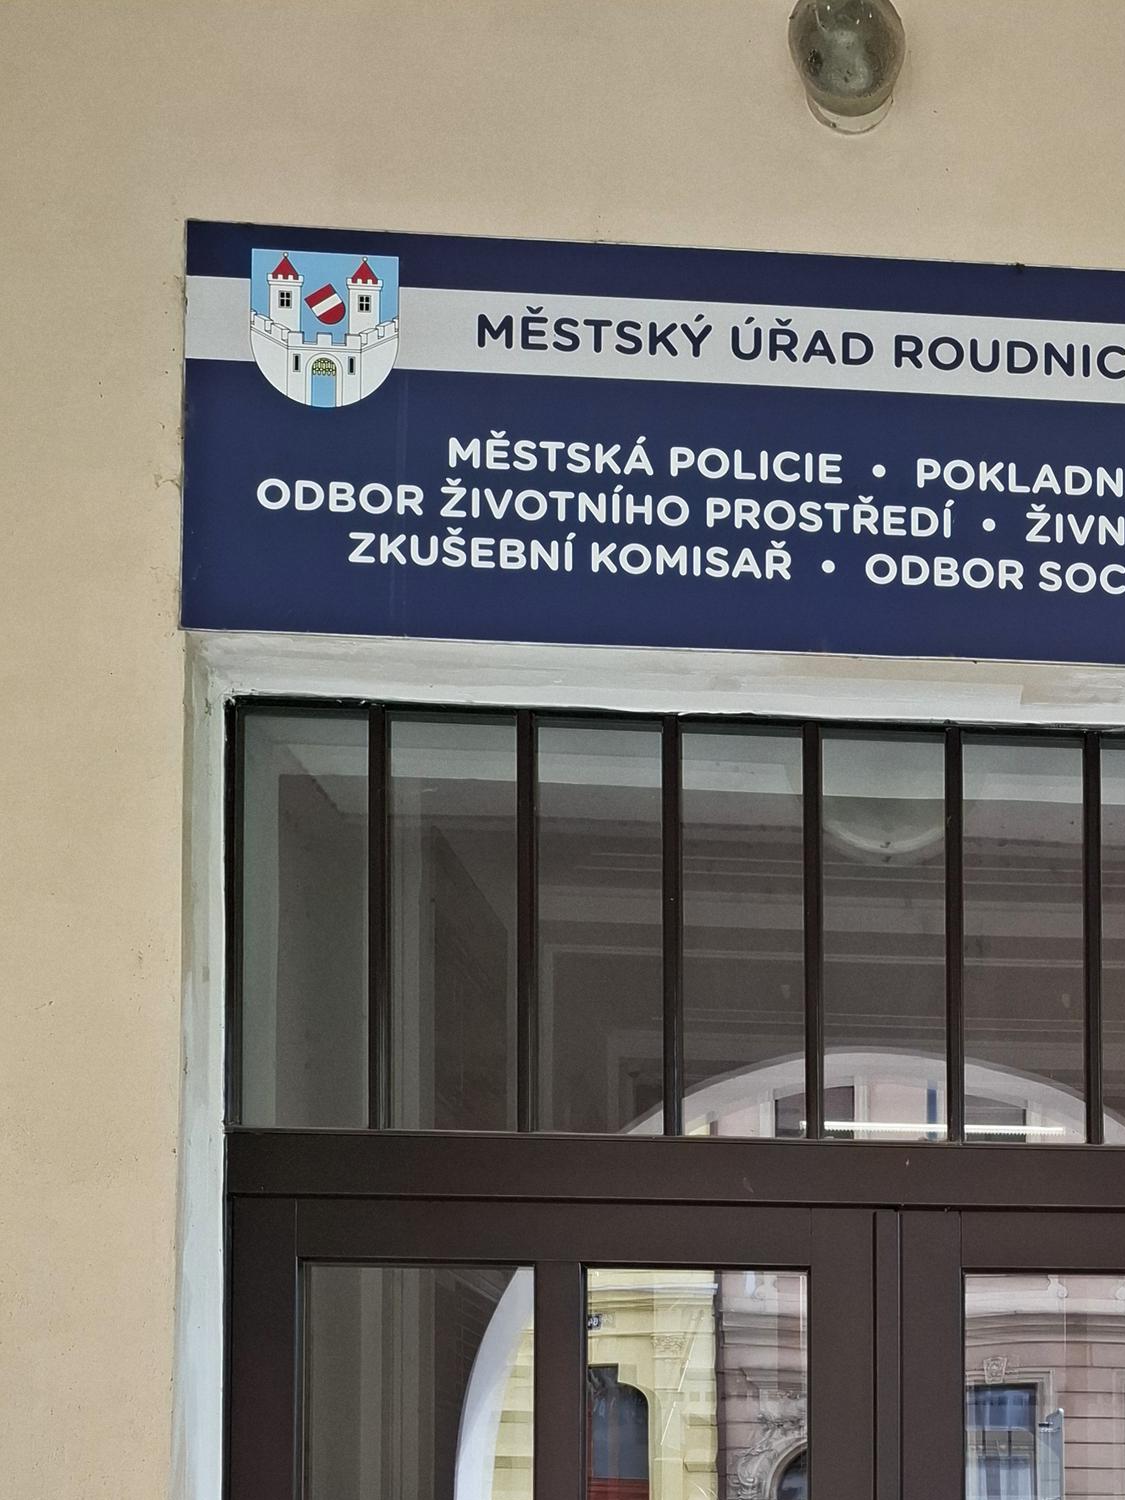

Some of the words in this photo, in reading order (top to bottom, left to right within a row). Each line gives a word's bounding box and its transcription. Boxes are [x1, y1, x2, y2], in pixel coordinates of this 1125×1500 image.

[477, 305, 713, 358] MĚSTSKÝ
[731, 316, 874, 366] ÚŘAD
[448, 429, 654, 476] MĚSTSKÁ
[669, 446, 843, 484] POLICIE
[256, 478, 424, 516] ODBOR
[439, 477, 690, 527] ŽIVOTNÍHO
[706, 494, 955, 539] PROSTŘEDÍ
[348, 526, 577, 572] ZKUŠEBNÍ
[591, 540, 792, 581] KOMISAŘ
[865, 553, 1024, 591] ODBOR
